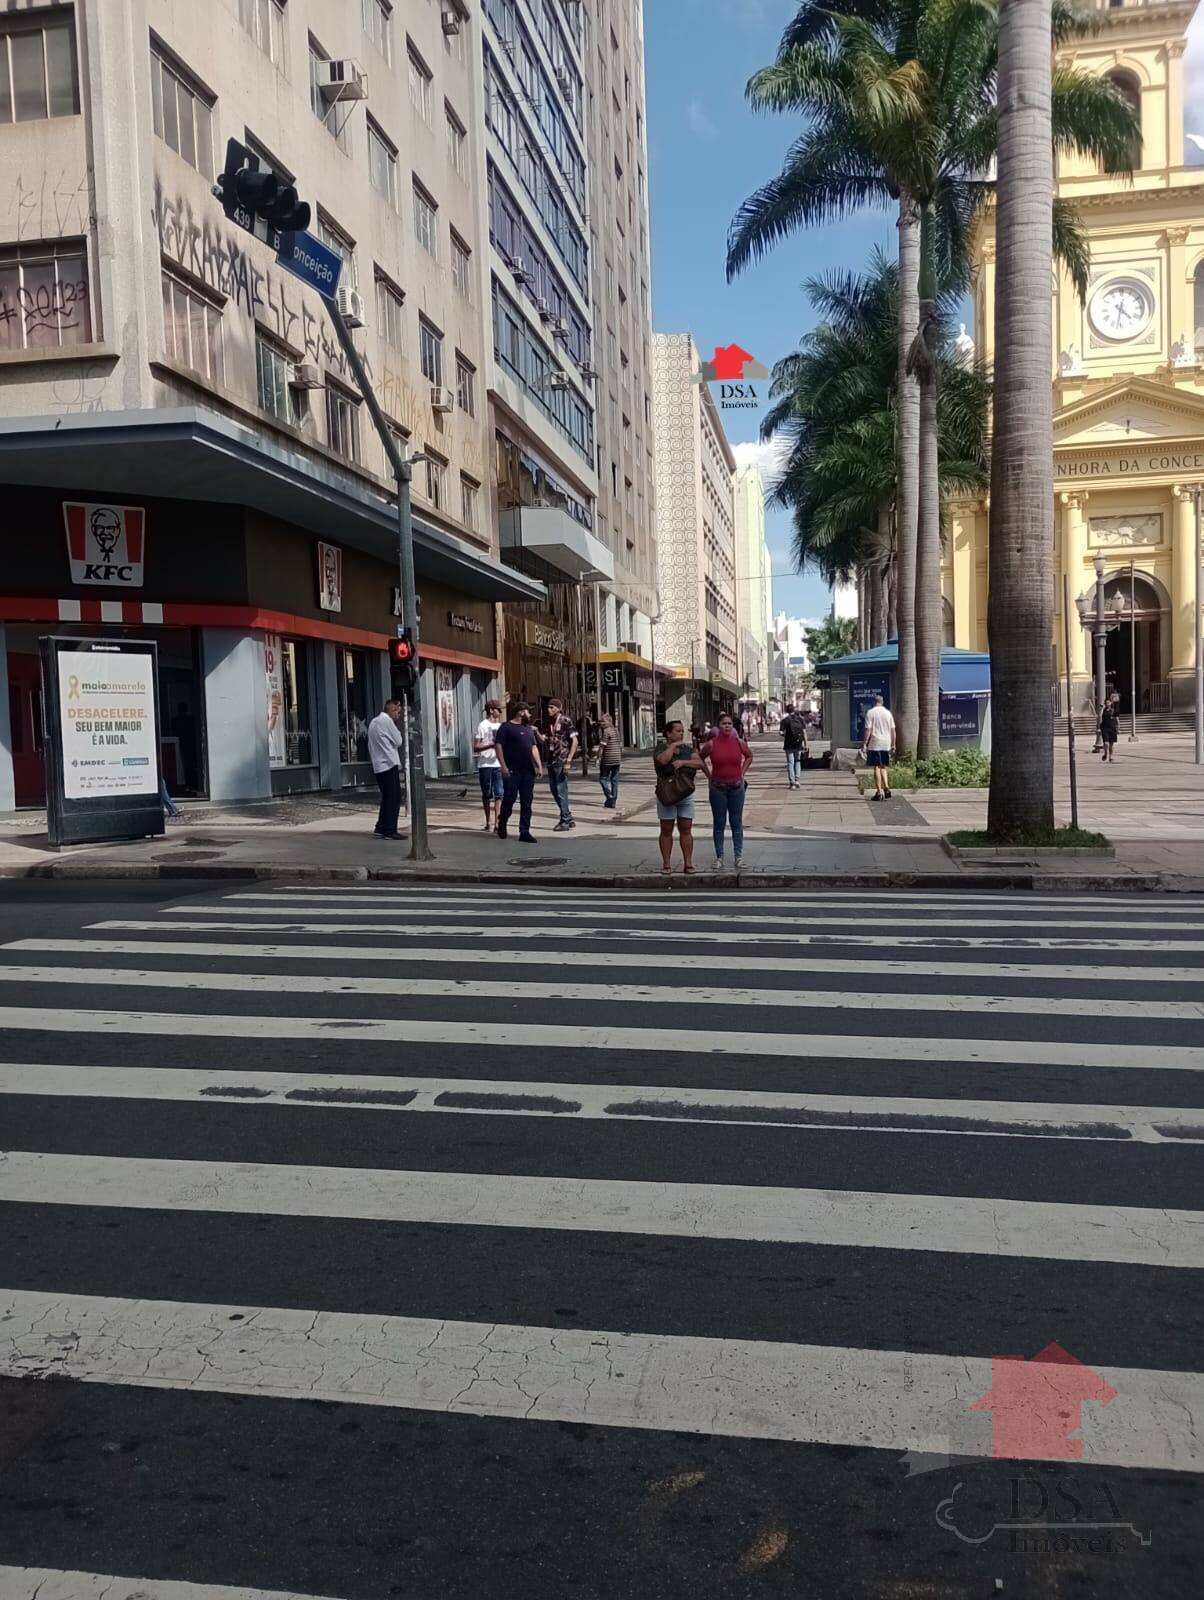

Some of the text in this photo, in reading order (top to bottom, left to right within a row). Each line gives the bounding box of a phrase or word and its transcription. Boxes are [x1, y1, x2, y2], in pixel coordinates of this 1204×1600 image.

[233, 207, 251, 229] 439
[293, 246, 334, 283] onceição
[1057, 454, 1204, 476] NHORA DA CONCE
[83, 564, 132, 581] KFC
[67, 708, 148, 719] DESACELERE.
[75, 721, 142, 732] SEU BEM MAIOR
[92, 733, 128, 745] É A VIDA.
